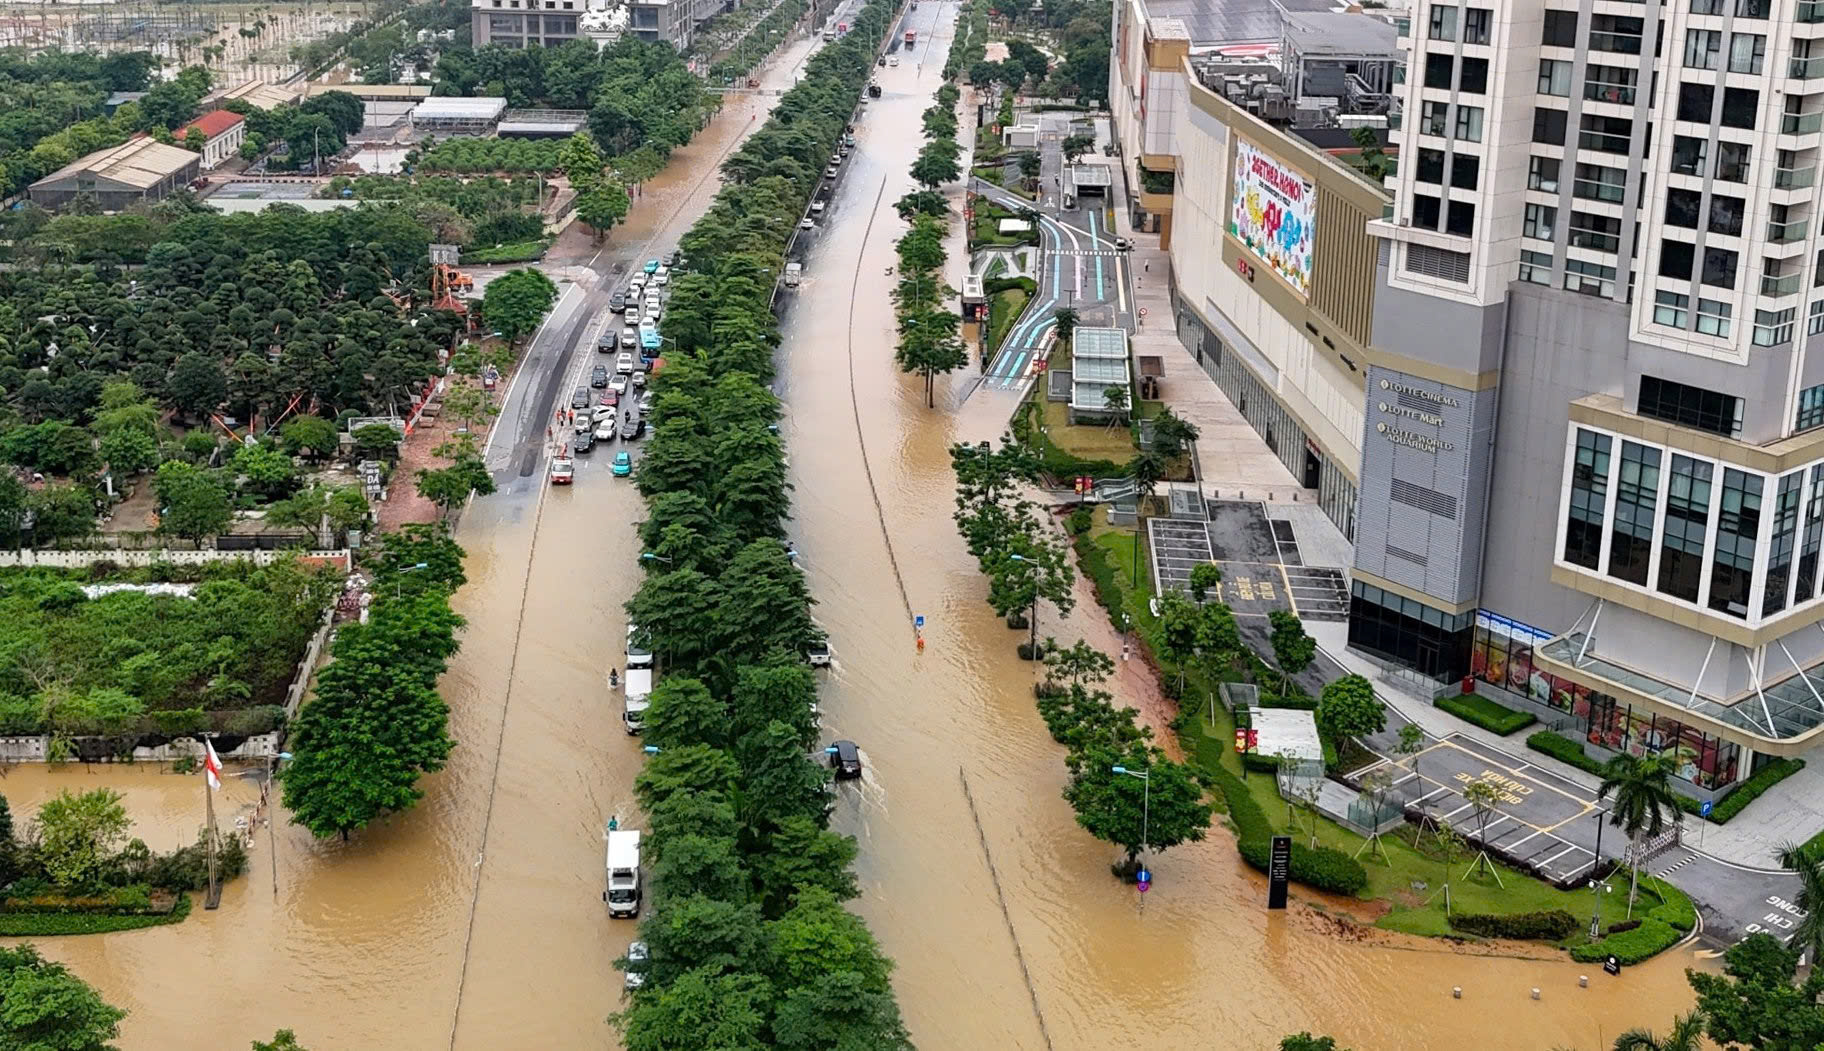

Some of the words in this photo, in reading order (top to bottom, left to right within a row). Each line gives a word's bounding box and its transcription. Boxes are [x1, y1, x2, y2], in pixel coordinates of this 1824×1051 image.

[1390, 382, 1420, 396] LOTTE
[1421, 391, 1458, 407] CINEMA
[1388, 404, 1418, 419] LOTTE
[1420, 413, 1443, 427] Mart
[1387, 426, 1415, 439] LOTTE
[1418, 434, 1453, 450] WORLD
[1387, 434, 1436, 453] AQUARIUM
